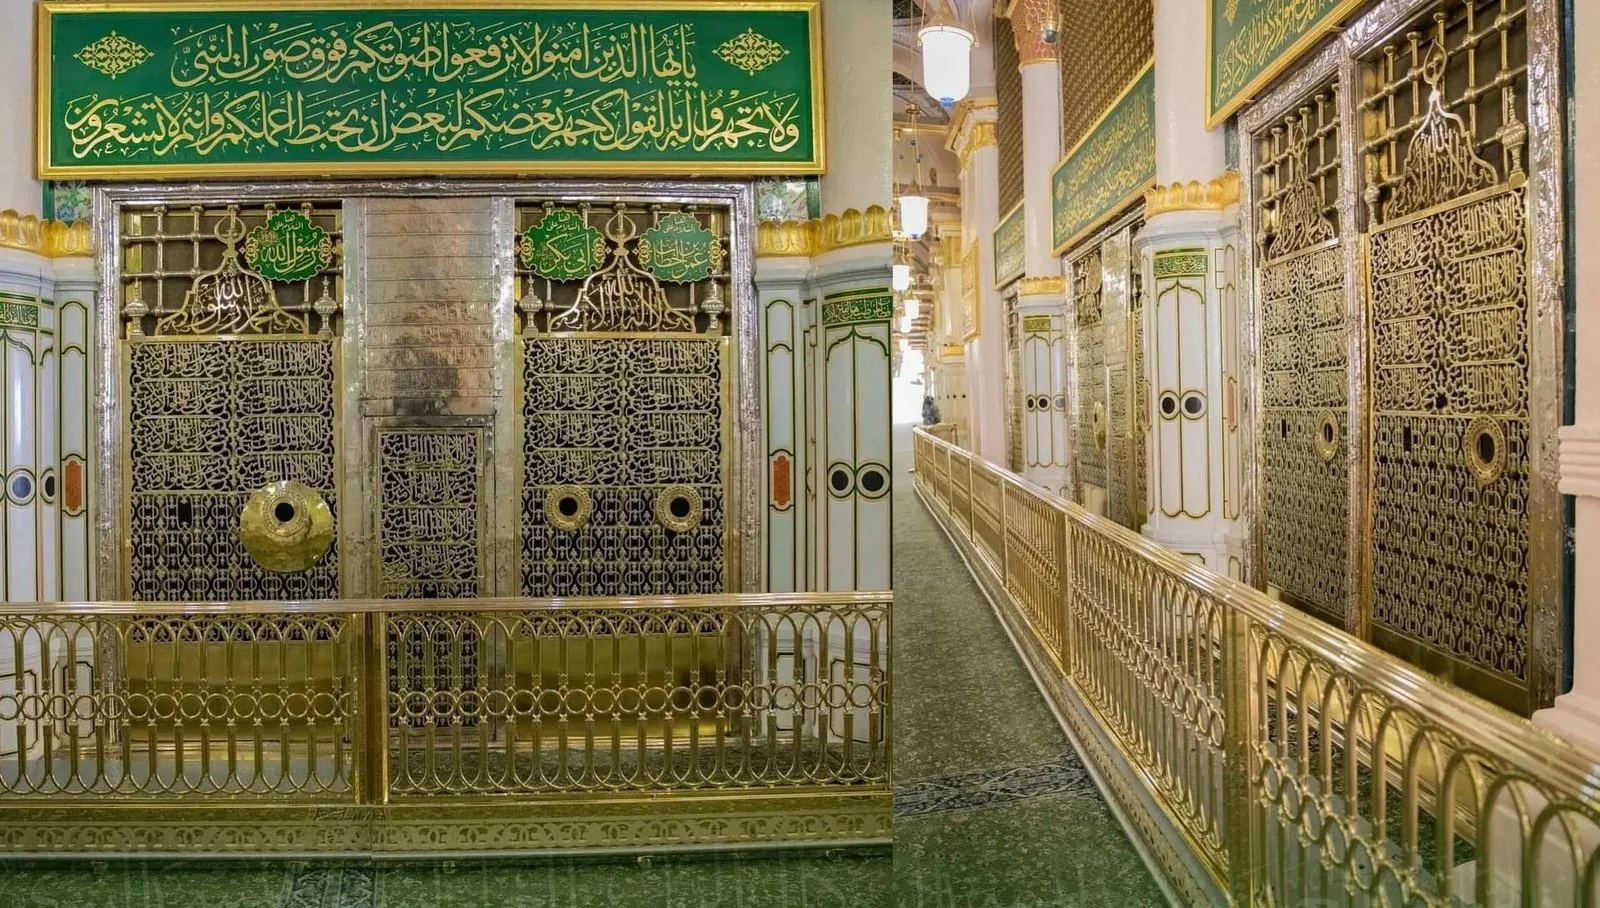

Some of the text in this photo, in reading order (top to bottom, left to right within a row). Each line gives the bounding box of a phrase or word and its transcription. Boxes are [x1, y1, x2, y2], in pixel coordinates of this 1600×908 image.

[286, 29, 348, 84] فوق
[433, 21, 517, 84] ترفعوا
[570, 22, 648, 84] الذين
[260, 230, 291, 268] الله
[273, 230, 319, 275] رسول
